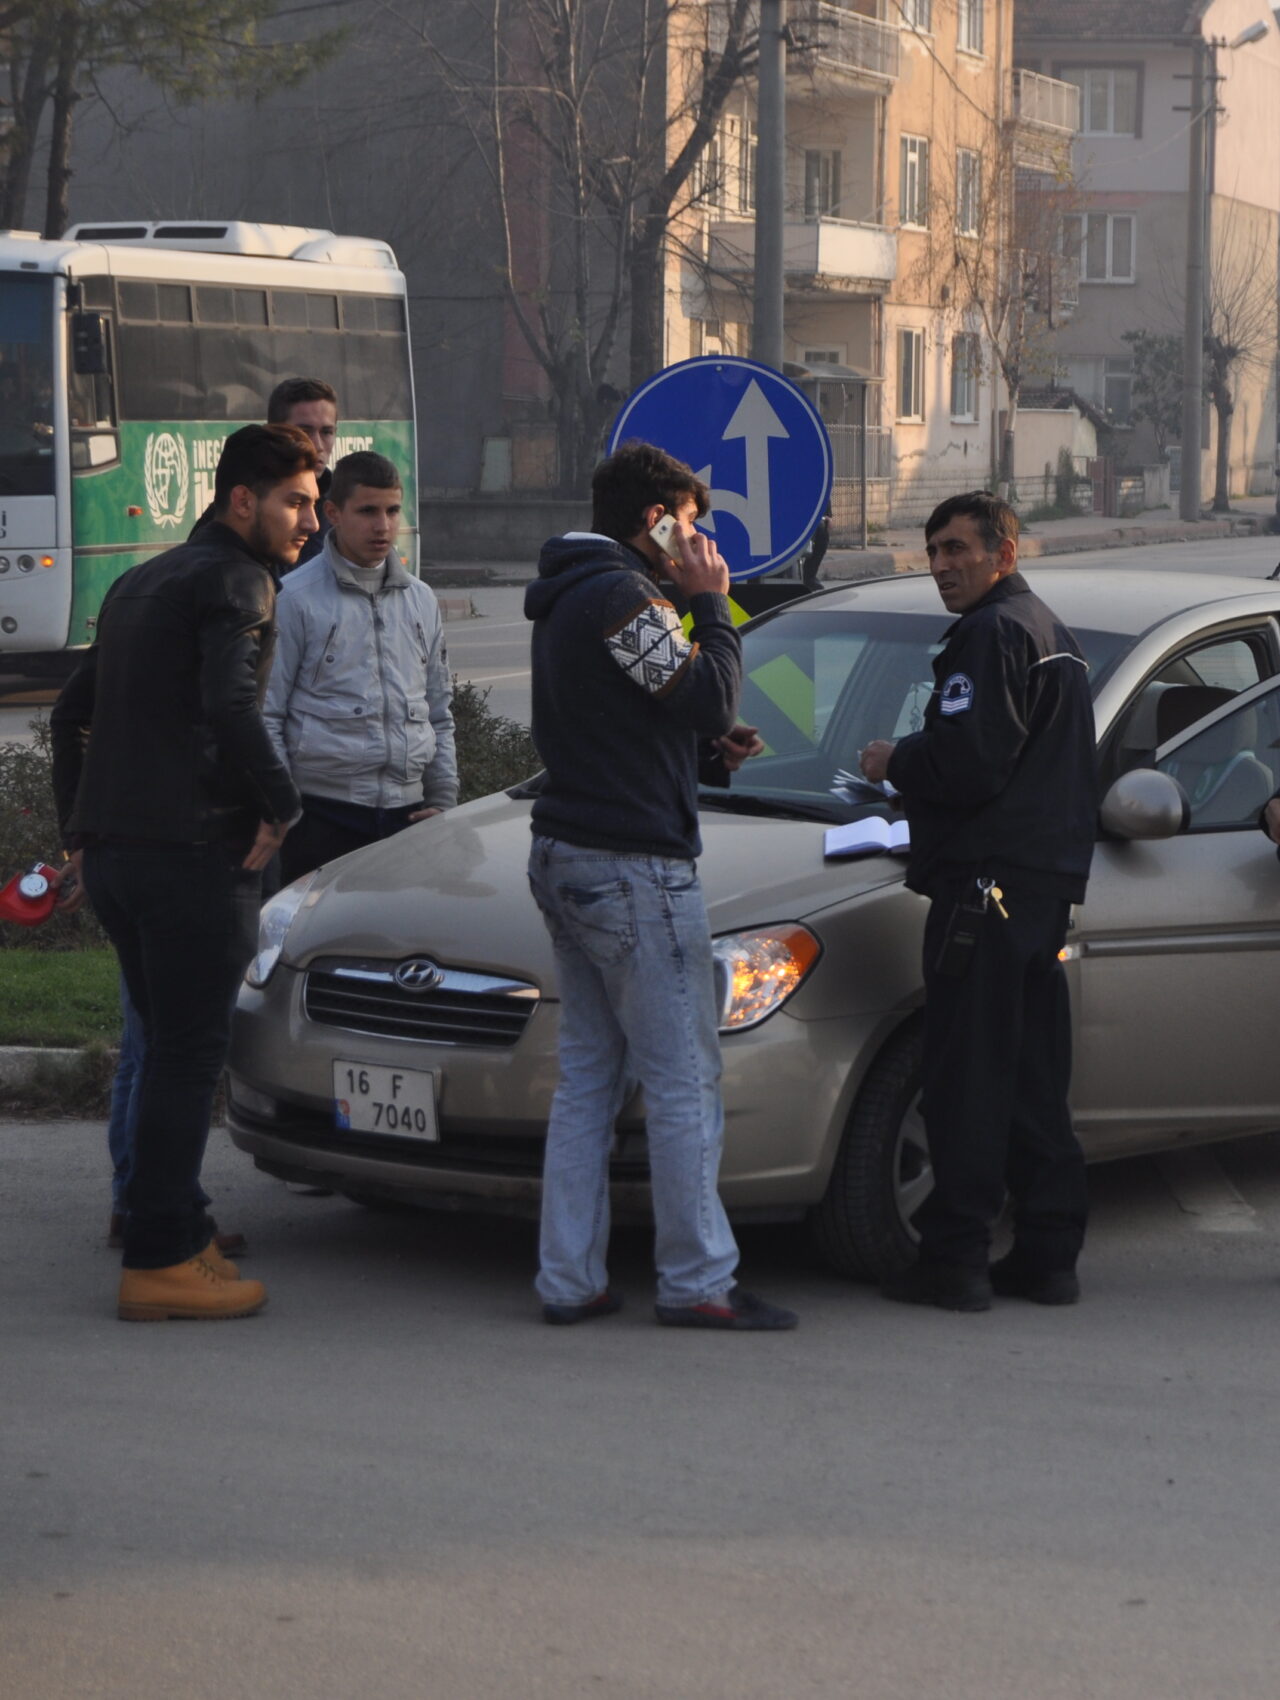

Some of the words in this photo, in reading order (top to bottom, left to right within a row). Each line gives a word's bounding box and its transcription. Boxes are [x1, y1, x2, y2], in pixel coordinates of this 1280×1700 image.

[347, 1069, 370, 1095] 16
[392, 1074, 403, 1099] F
[372, 1102, 426, 1132] 7040
